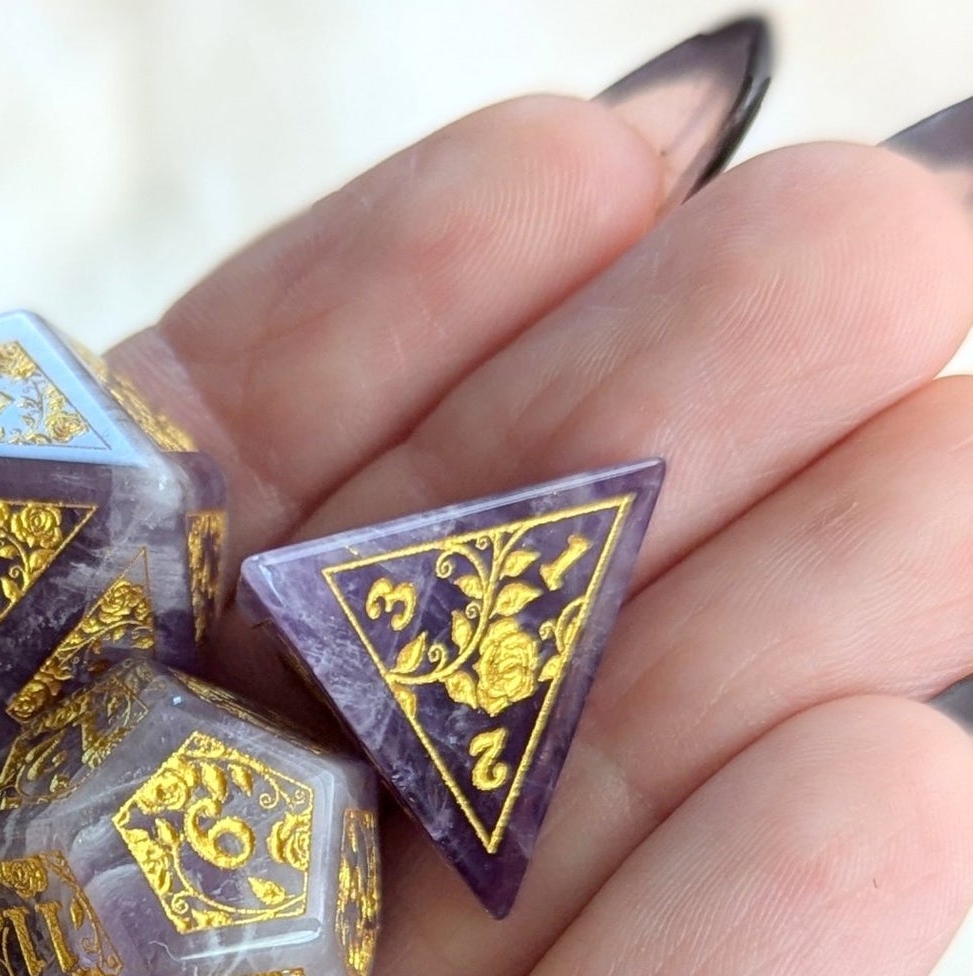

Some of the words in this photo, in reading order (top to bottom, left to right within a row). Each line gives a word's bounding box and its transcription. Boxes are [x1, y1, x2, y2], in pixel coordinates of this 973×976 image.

[540, 534, 593, 590] 1
[367, 577, 417, 631] 3
[469, 727, 508, 790] 2
[184, 798, 254, 869] 6
